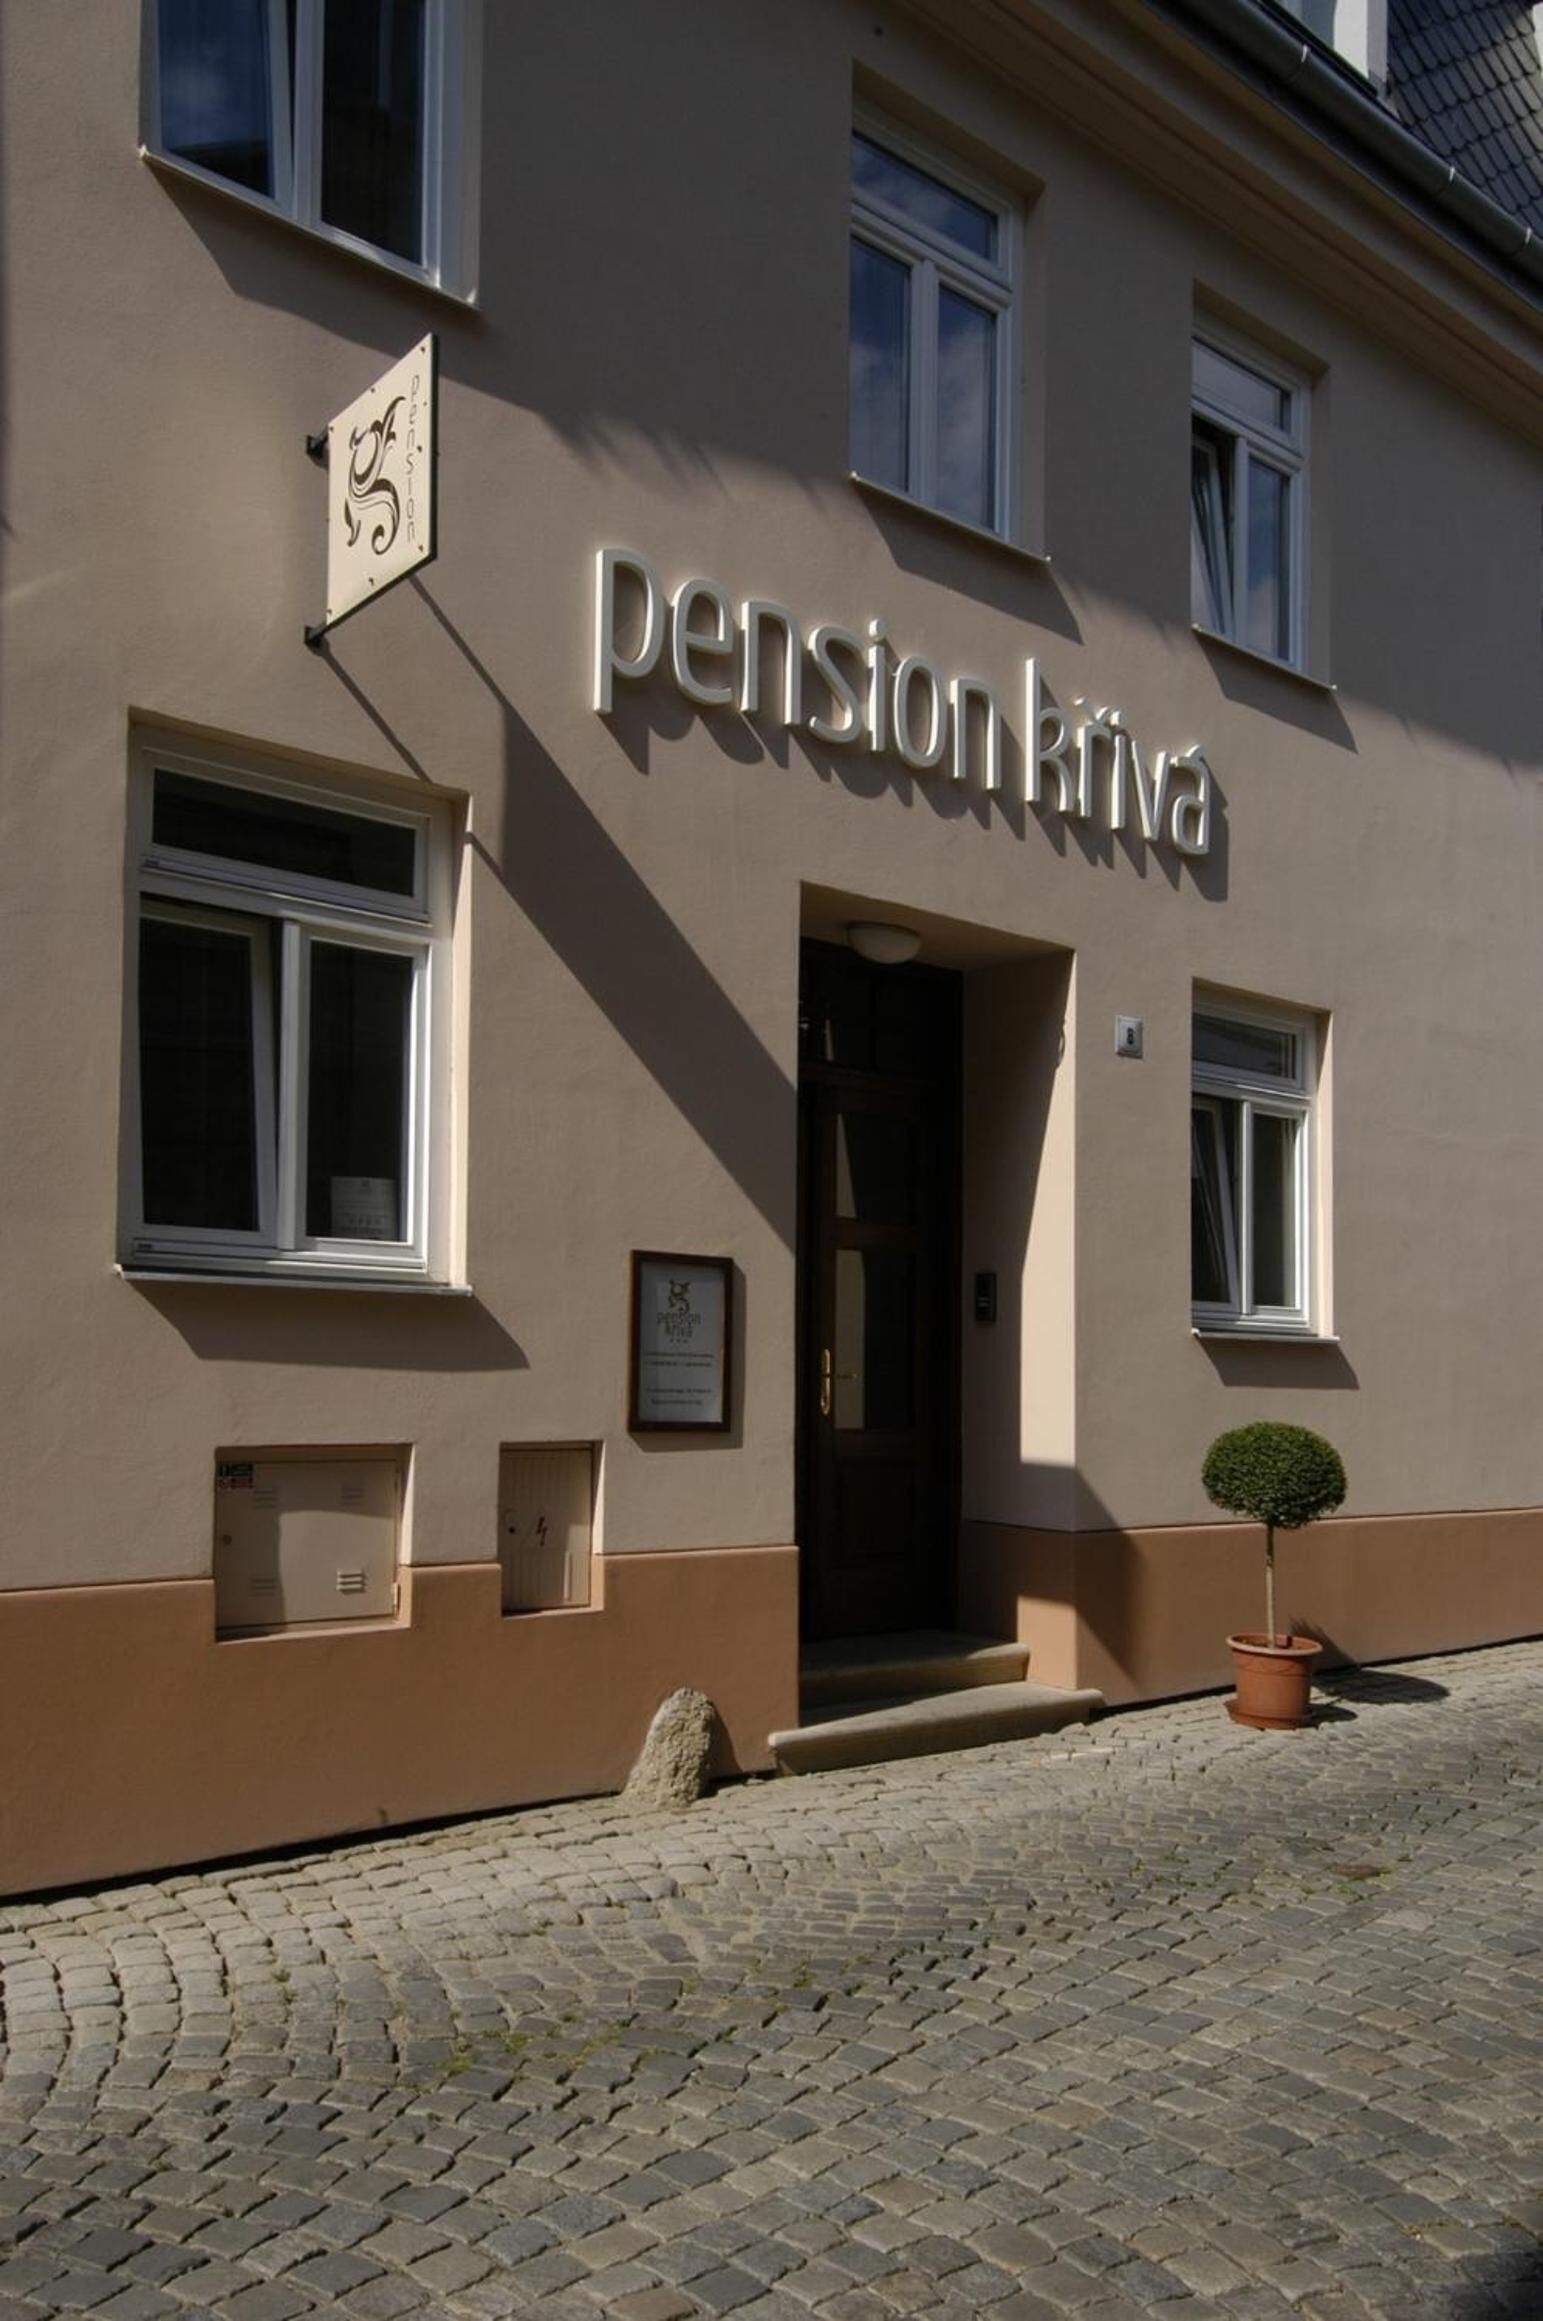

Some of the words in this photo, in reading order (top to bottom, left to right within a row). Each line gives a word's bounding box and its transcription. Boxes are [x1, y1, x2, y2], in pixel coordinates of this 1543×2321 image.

[404, 374, 421, 544] pension
[592, 547, 1004, 790] pension
[1025, 657, 1212, 857] křivá
